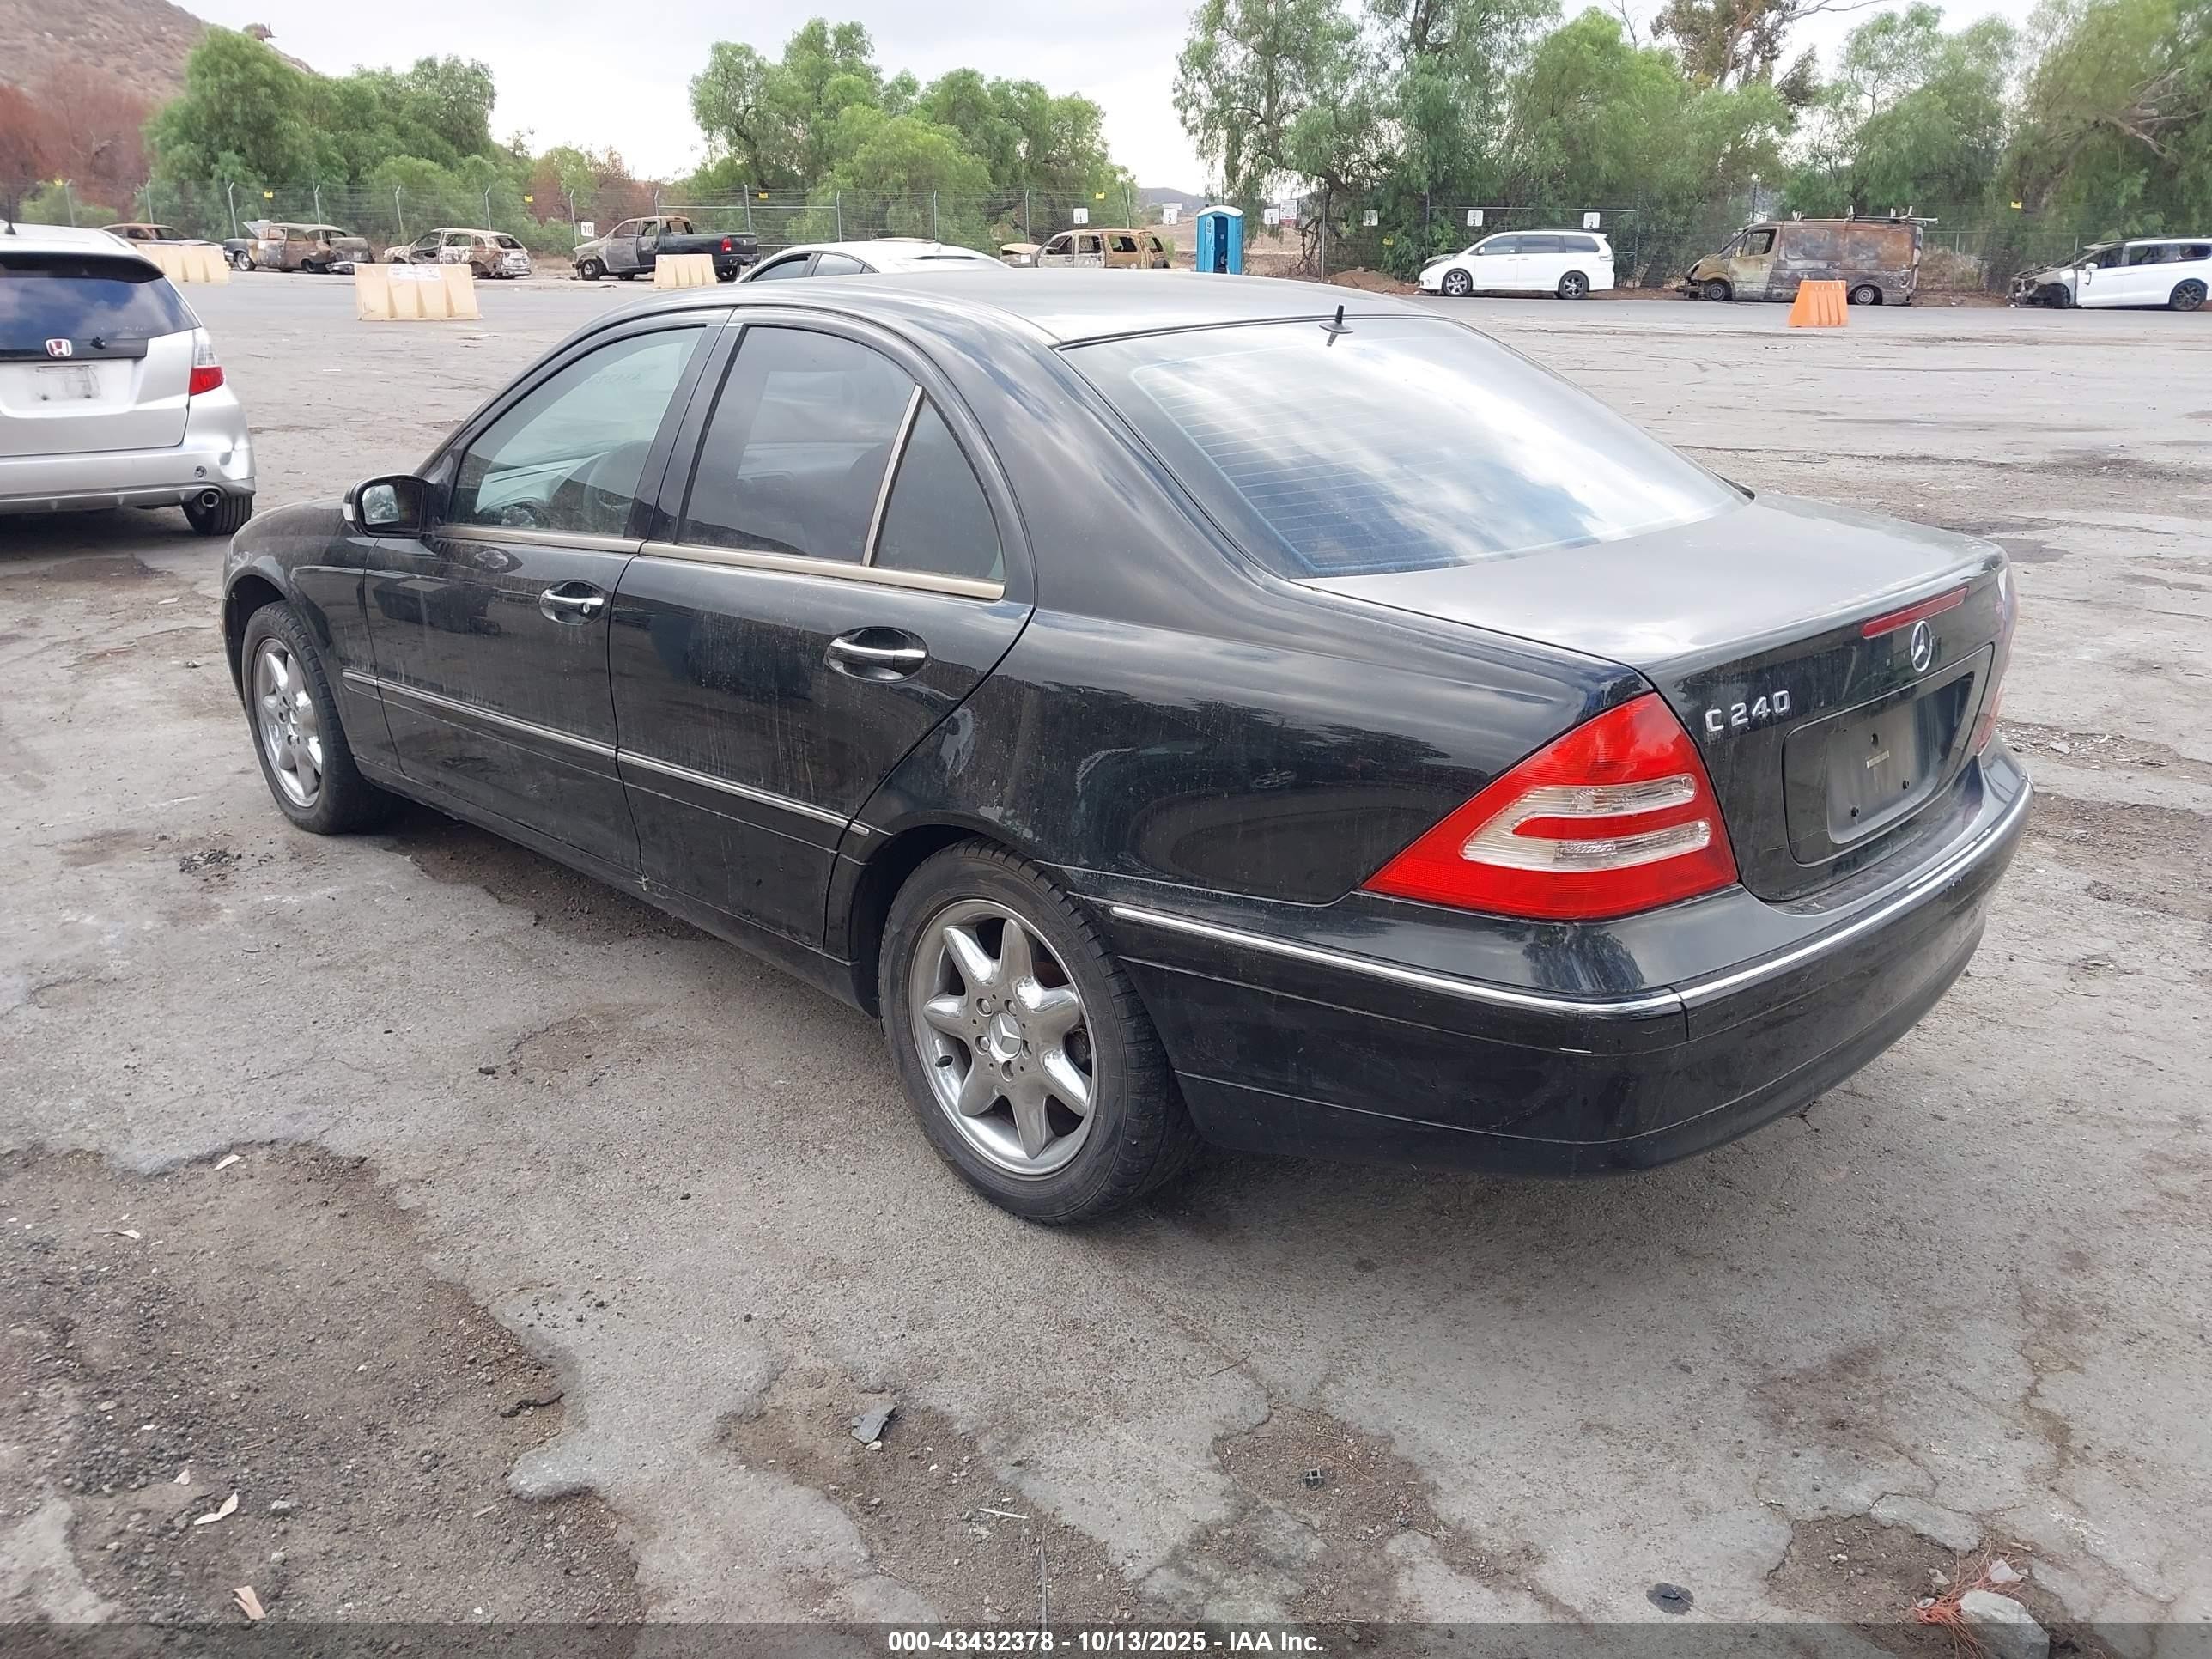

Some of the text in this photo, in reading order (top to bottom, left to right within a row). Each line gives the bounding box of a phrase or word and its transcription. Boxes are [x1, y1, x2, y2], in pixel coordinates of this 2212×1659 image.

[582, 224, 592, 234] 10
[1705, 690, 1790, 732] C 240
